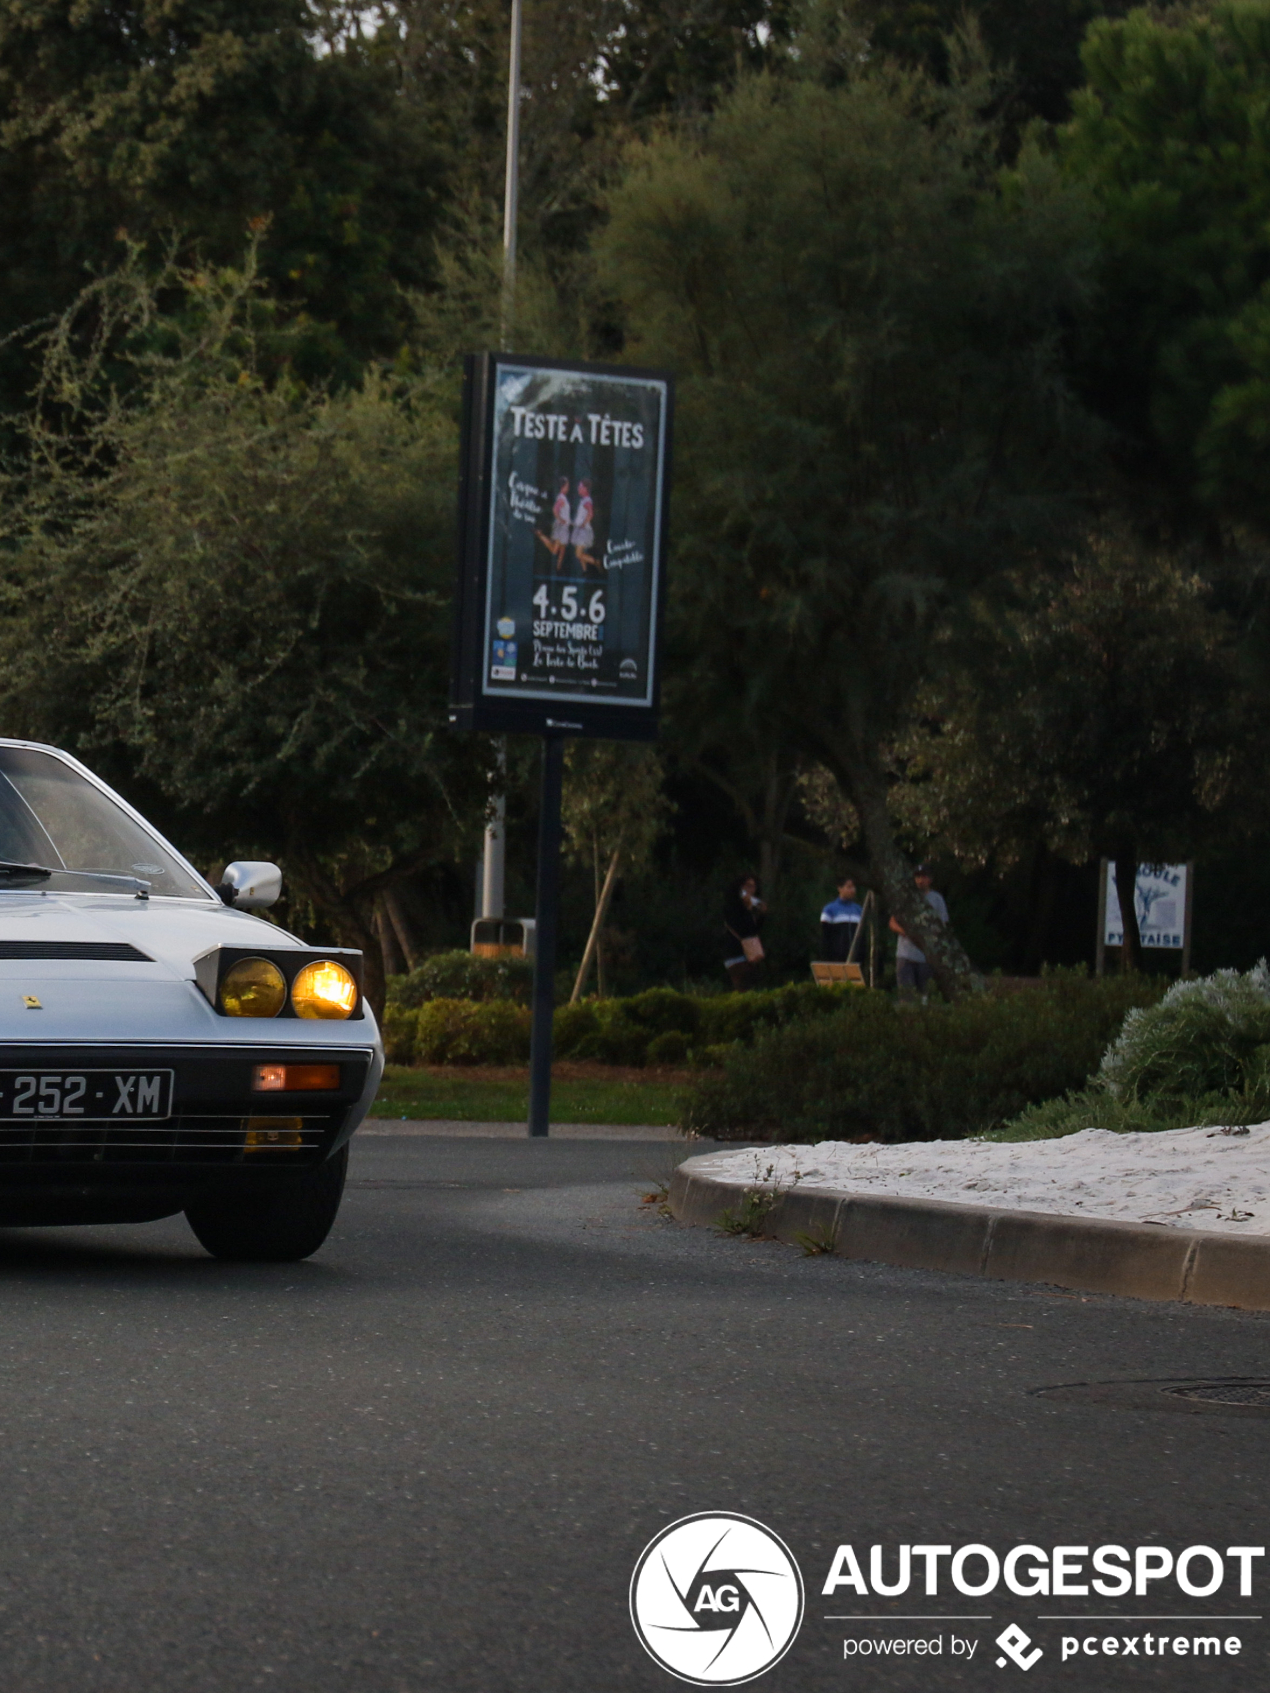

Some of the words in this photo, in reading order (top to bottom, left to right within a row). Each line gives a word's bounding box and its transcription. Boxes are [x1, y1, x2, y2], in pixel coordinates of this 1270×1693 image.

[510, 406, 568, 442] TESTE
[587, 412, 644, 450] TÊTES
[533, 620, 598, 641] SEPTEMBRE
